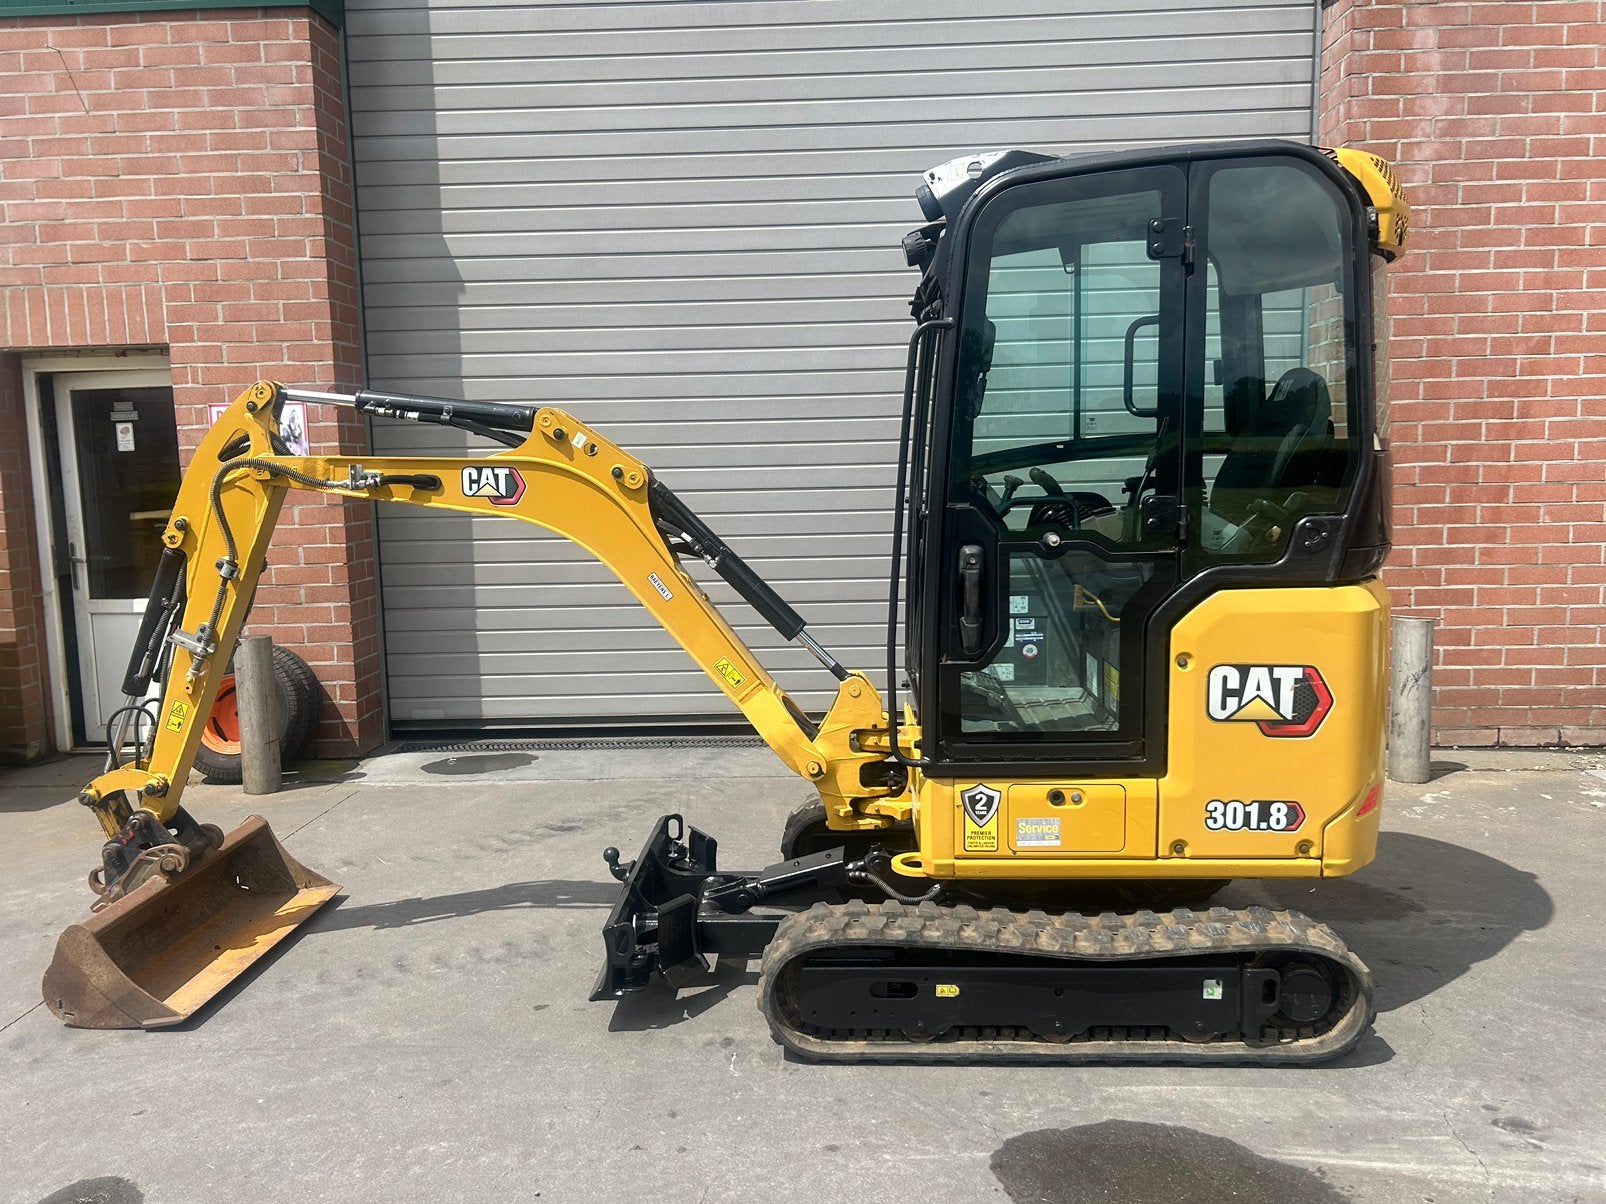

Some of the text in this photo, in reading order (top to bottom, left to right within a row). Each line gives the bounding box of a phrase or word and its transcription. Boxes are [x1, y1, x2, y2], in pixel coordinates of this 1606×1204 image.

[462, 466, 510, 497] CAT
[1208, 665, 1303, 720] CAT
[975, 793, 988, 810] 2
[1206, 800, 1288, 830] 301.8
[1018, 821, 1059, 834] Service
